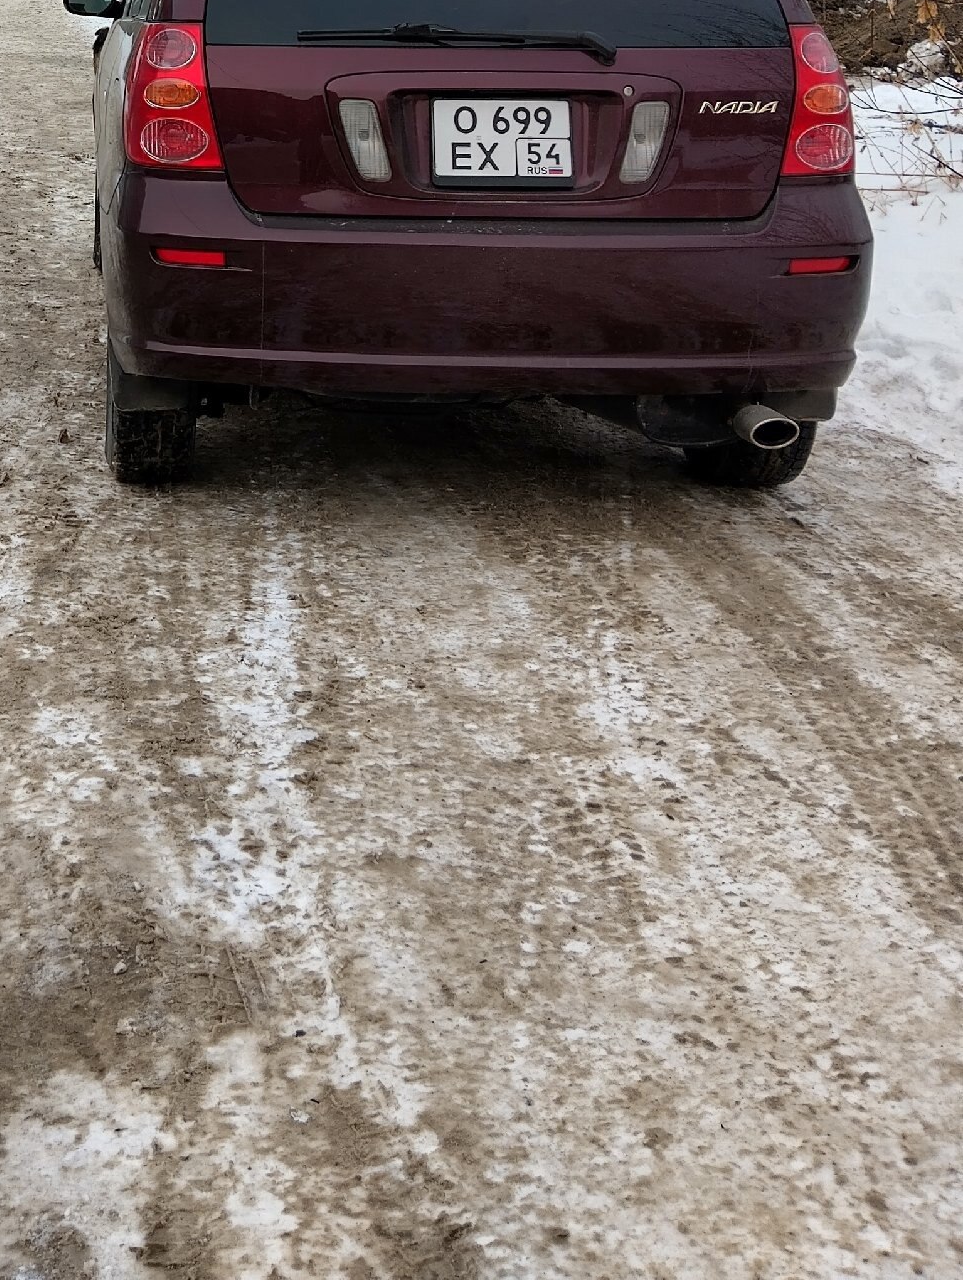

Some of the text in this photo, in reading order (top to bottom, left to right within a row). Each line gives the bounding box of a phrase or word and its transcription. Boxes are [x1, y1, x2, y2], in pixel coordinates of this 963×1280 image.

[698, 100, 780, 114] NADIA
[453, 105, 552, 135] О 699
[451, 142, 561, 171] ЕХ 54
[527, 166, 548, 175] RUS
